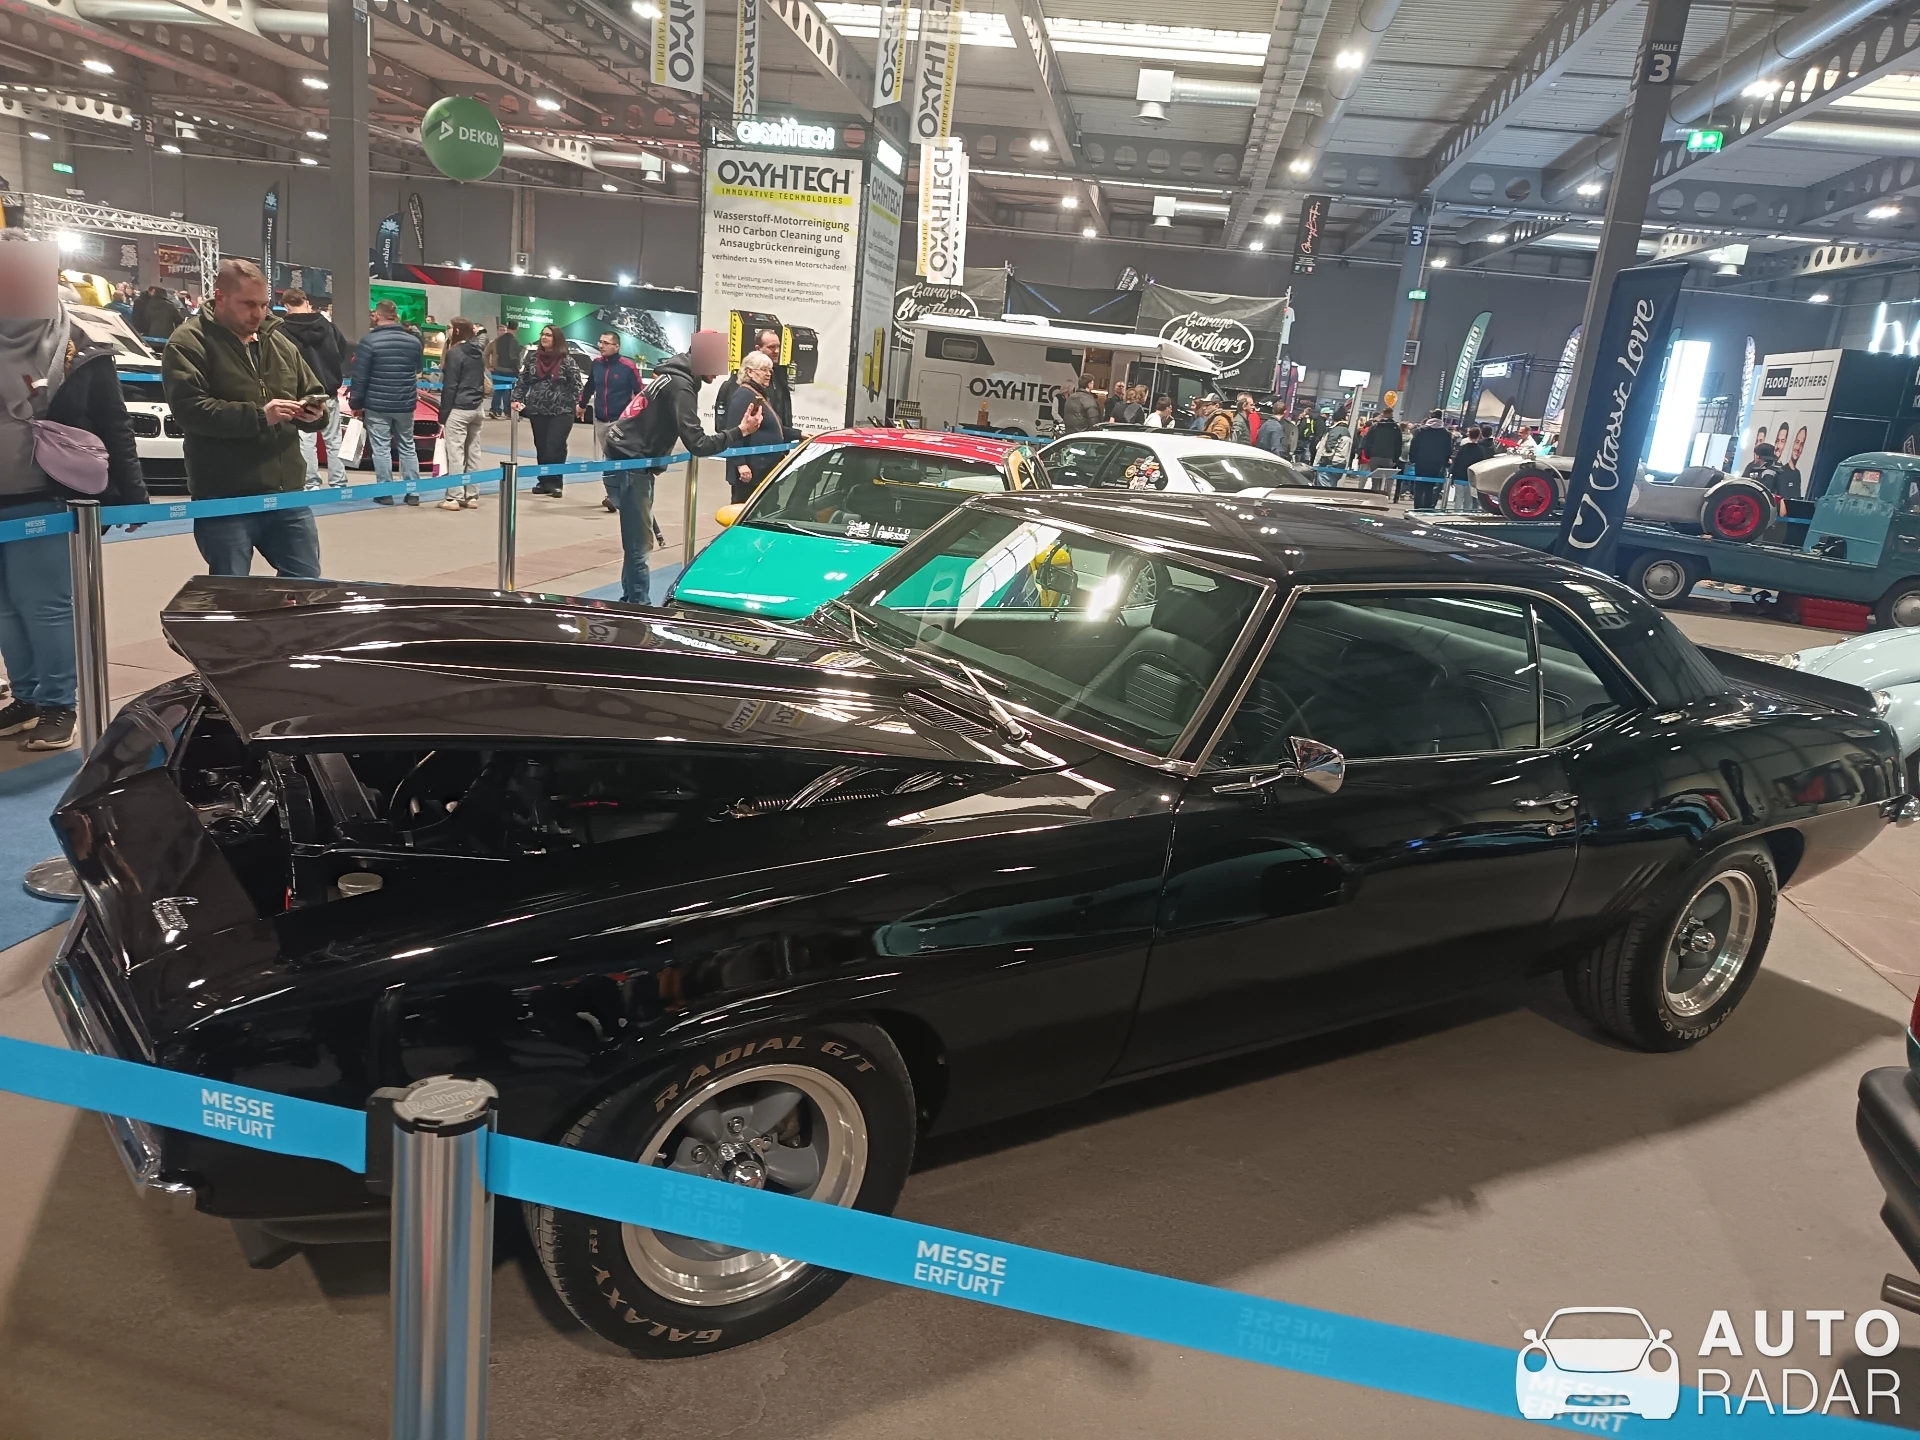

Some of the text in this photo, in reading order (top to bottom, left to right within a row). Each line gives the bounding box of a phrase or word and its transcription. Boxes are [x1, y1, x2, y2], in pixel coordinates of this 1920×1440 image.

[1652, 43, 1678, 52] HALLE
[1648, 53, 1671, 83] 3
[459, 127, 499, 148] DEKRA
[717, 159, 850, 195] OXYHTECH
[722, 187, 843, 205] INNOVATIVE TECHNOLOGIES
[713, 209, 850, 232] Wasserstoff-Motorreinigung
[718, 224, 843, 244] HHO Carbon Cleaning und
[1411, 231, 1423, 245] 3
[719, 238, 841, 259] Ansaugbrückenreinigung
[712, 253, 748, 263] verhindert
[758, 257, 773, 265] 95%
[774, 259, 794, 267] einen
[795, 260, 846, 271] Motorschaden!
[738, 275, 761, 284] Leistung
[912, 282, 958, 303] Garage
[1185, 311, 1234, 333] Garage
[1171, 326, 1247, 354] Brothers
[969, 377, 1062, 403] OXYHTEC
[1589, 382, 1632, 491] Classic
[25, 518, 46, 528] MESSE
[26, 526, 46, 535] ERFURT
[878, 525, 911, 534] AUTO
[655, 1036, 877, 1112] RADIAL G/T
[201, 1088, 275, 1120] MESSE
[203, 1109, 275, 1140] ERFURT
[916, 1239, 1008, 1277] MESSE
[913, 1262, 1005, 1297] ERFURT
[591, 1263, 724, 1344] GALAXY
